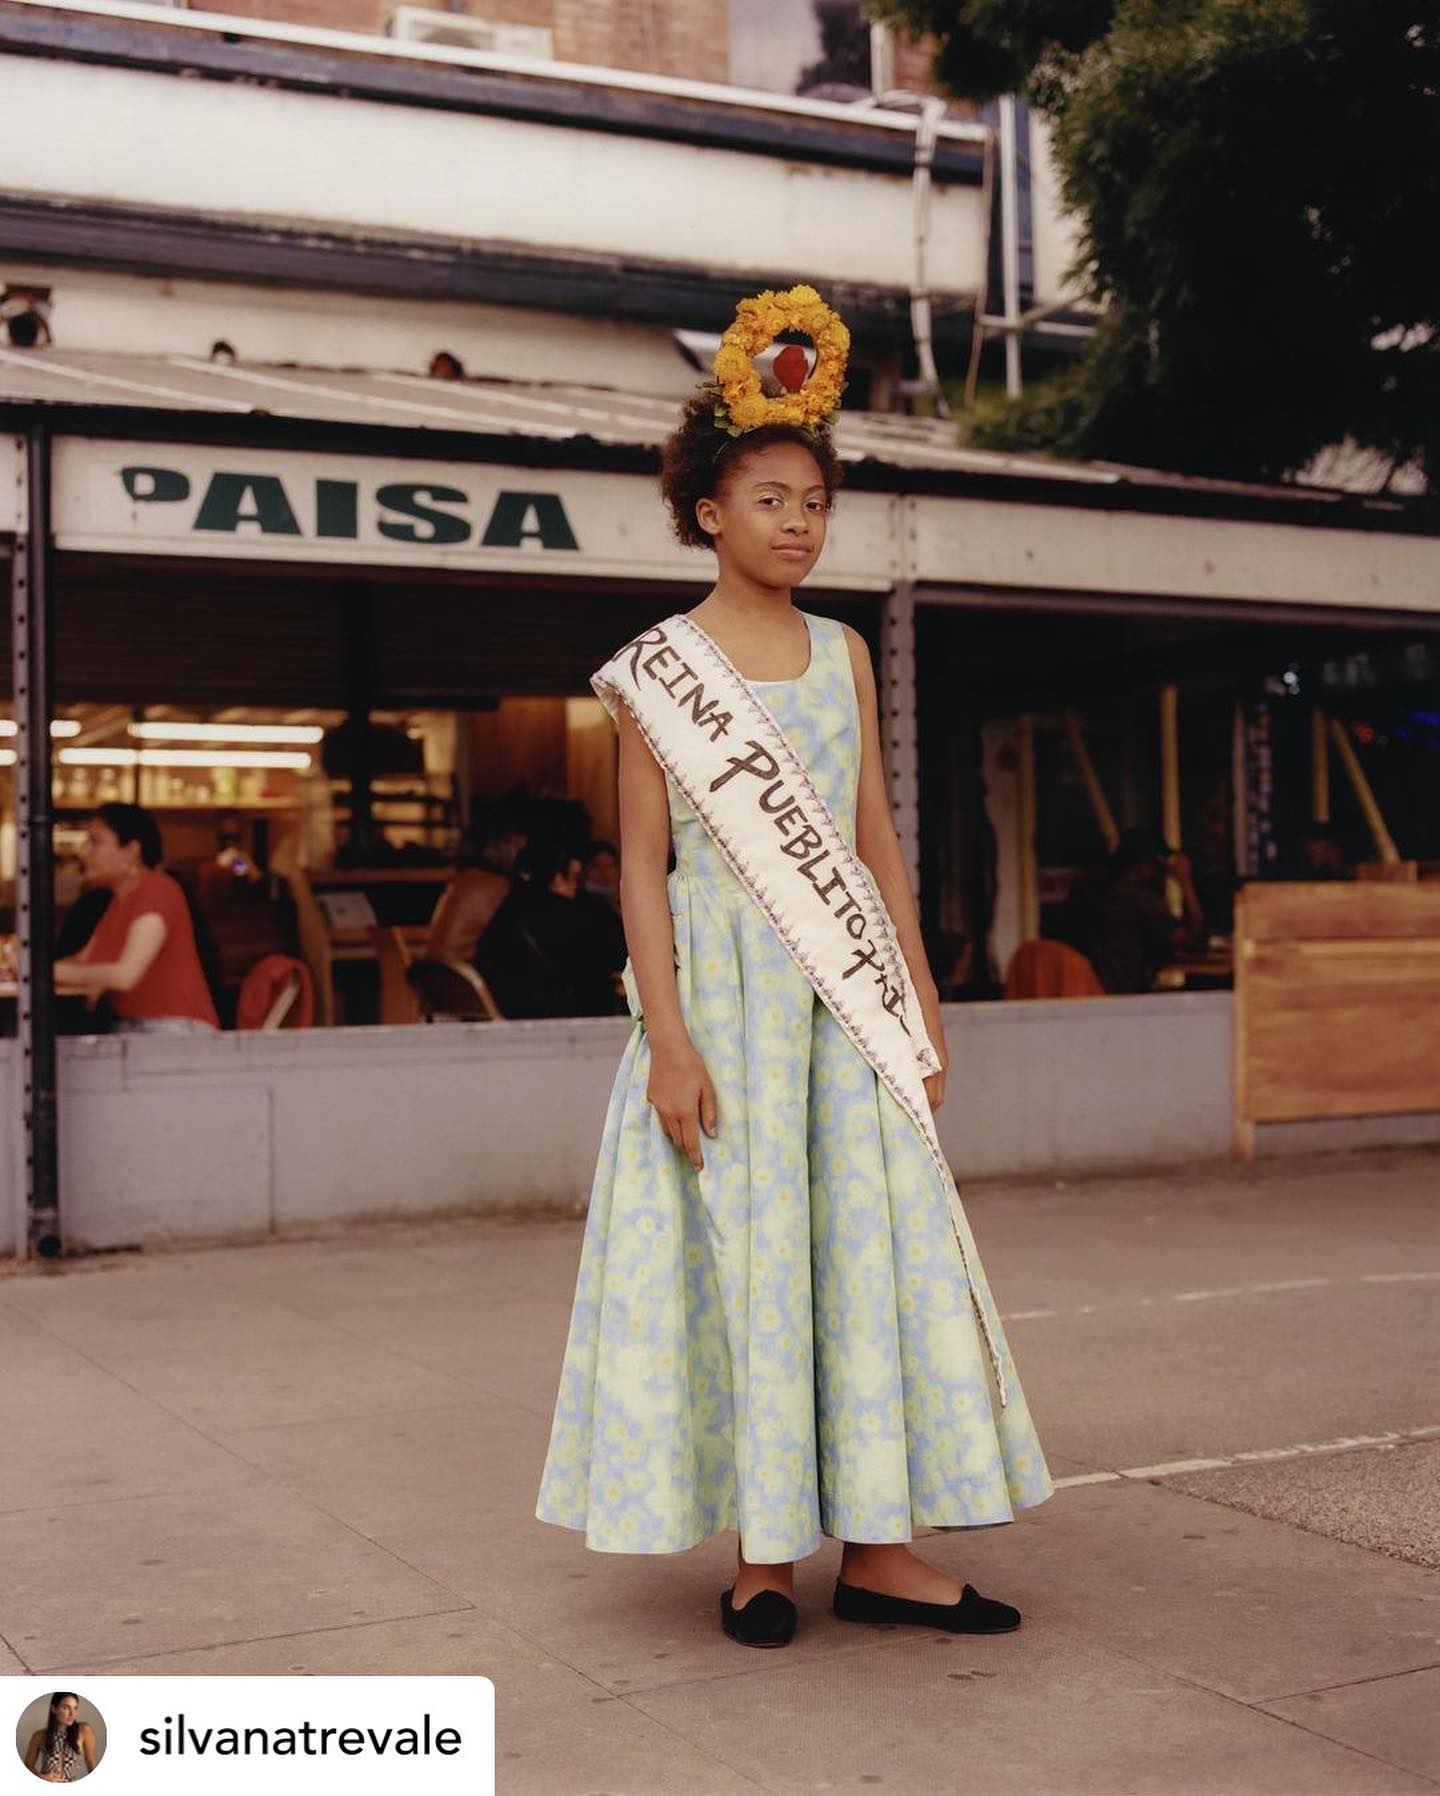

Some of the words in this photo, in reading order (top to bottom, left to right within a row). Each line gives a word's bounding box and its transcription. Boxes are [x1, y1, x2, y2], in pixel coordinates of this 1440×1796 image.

[119, 466, 580, 551] PAISA
[611, 626, 734, 743] REINA
[708, 740, 867, 940] PUEBLITO
